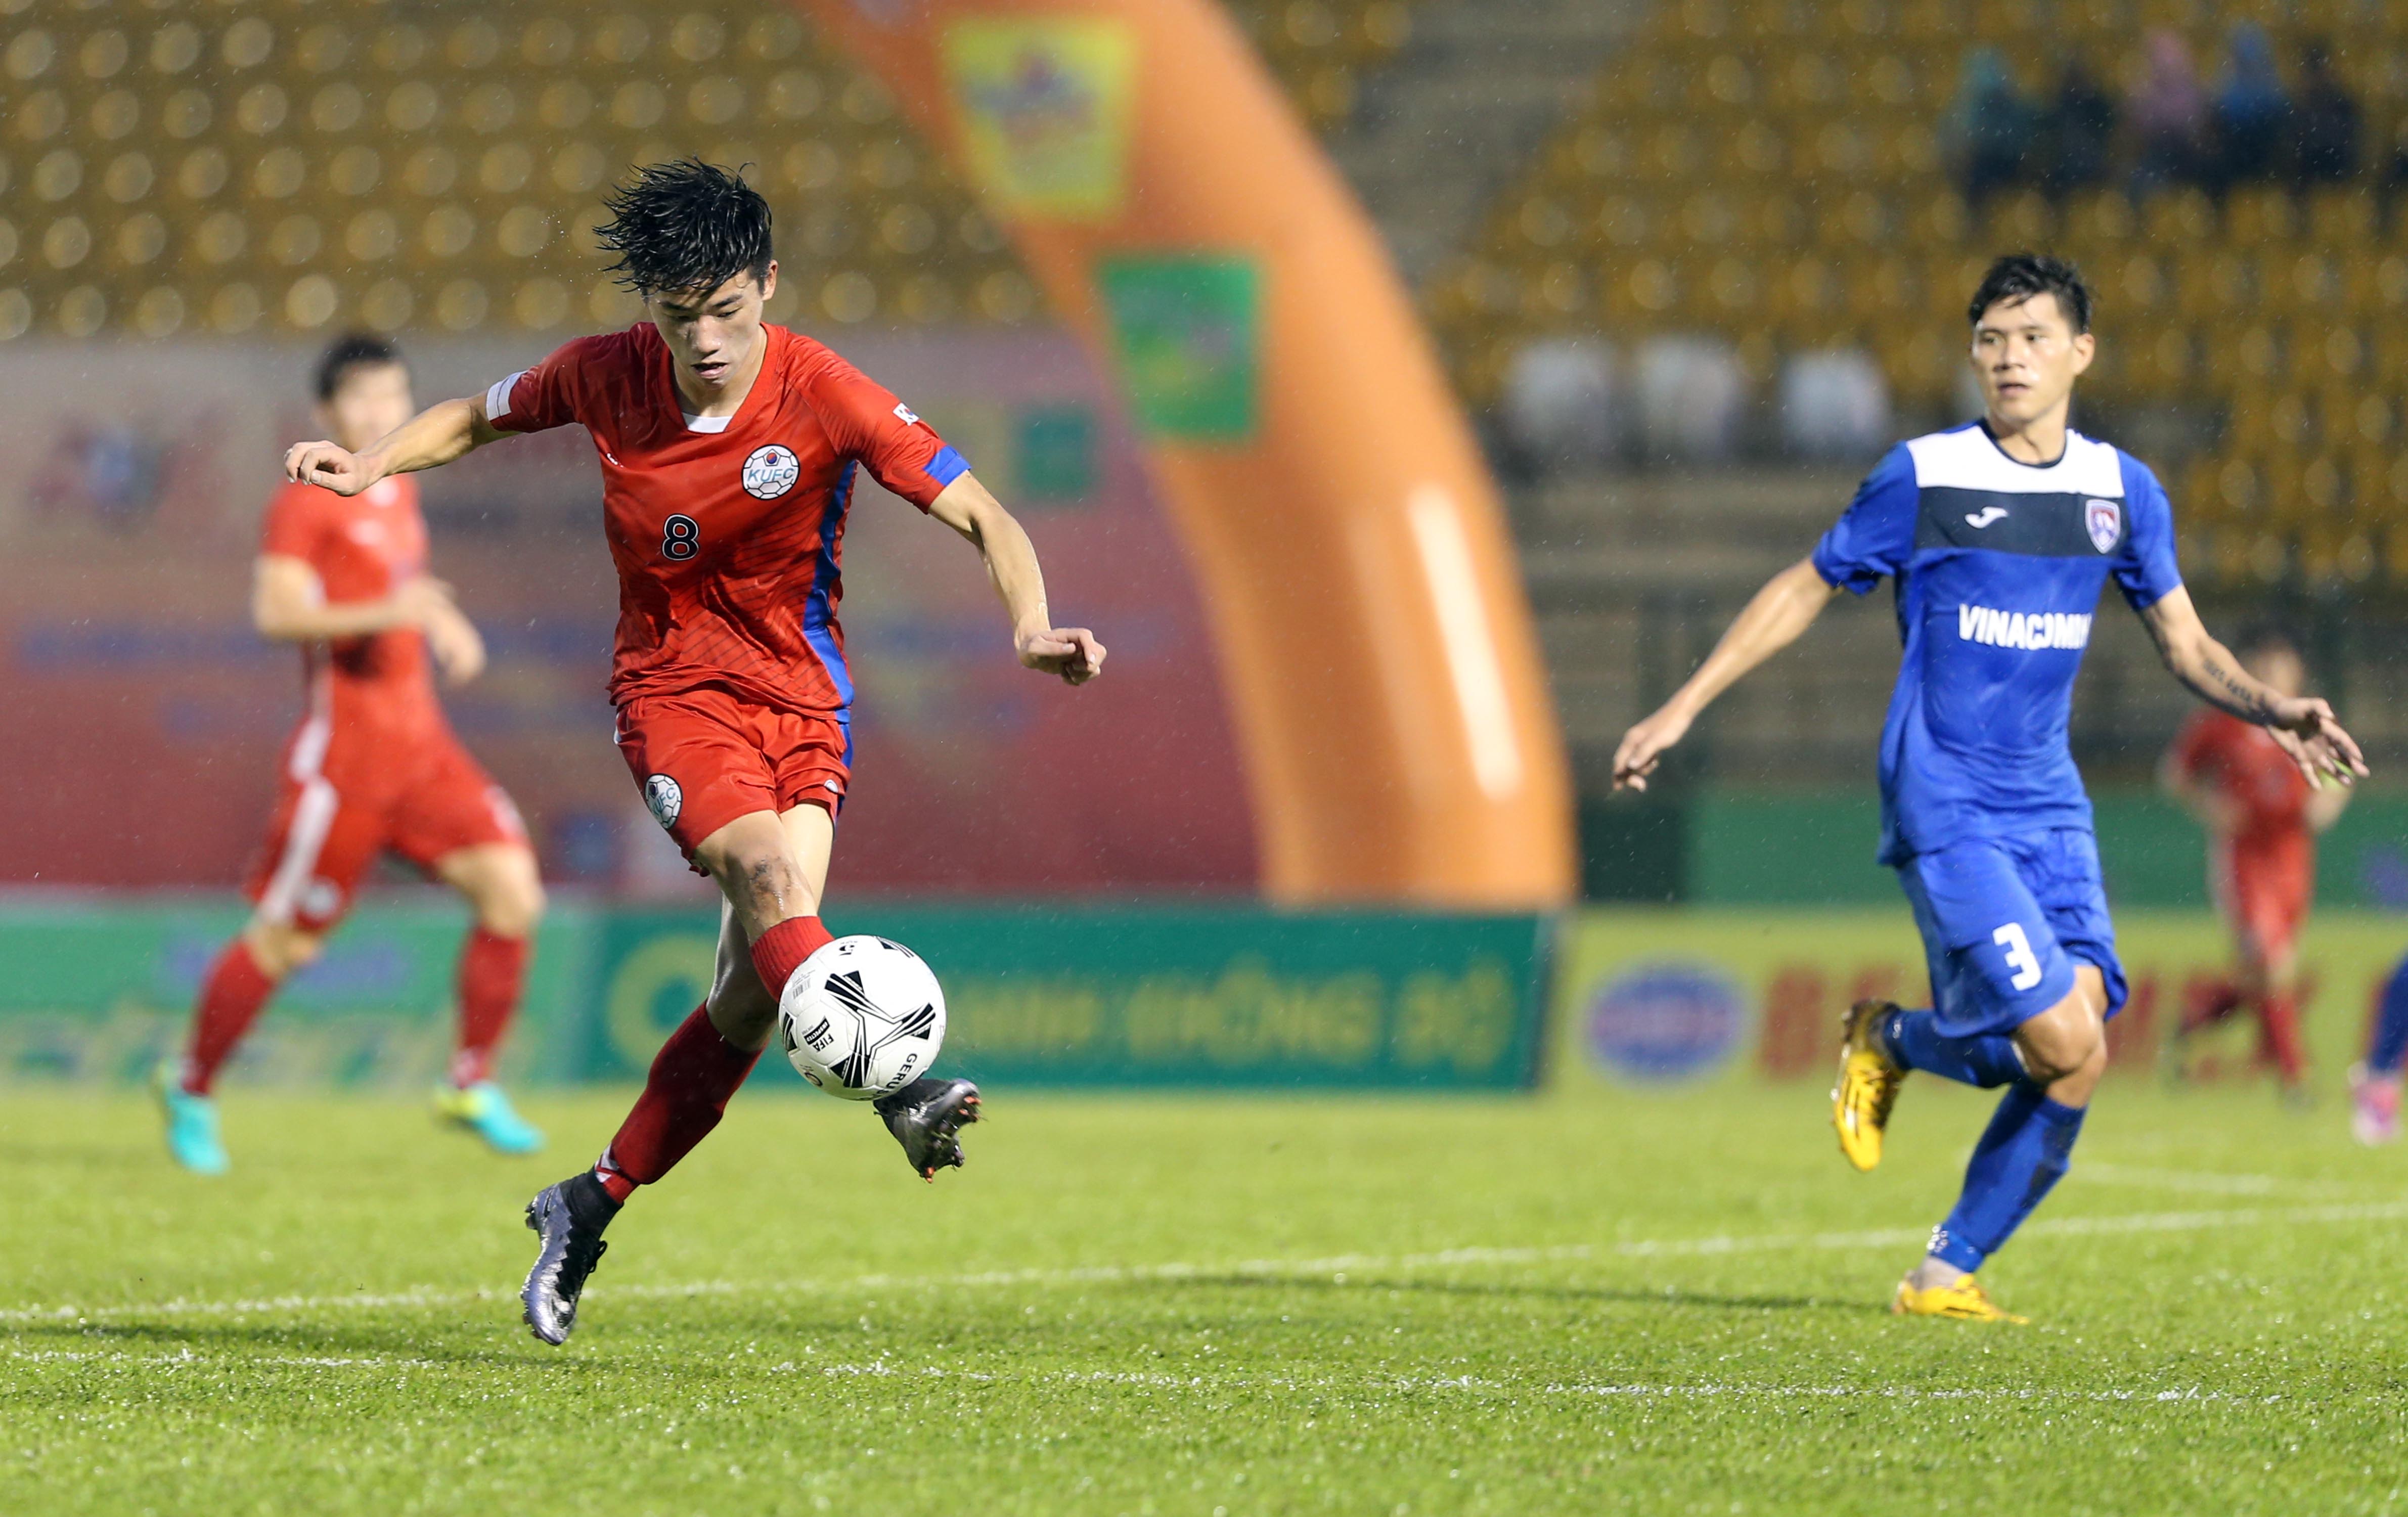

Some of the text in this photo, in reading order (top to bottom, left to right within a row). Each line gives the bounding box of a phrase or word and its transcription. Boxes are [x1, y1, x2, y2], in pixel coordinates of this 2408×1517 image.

[747, 468, 794, 482] KUFC
[662, 514, 699, 561] 8
[1992, 921, 2042, 992] 3
[812, 1033, 835, 1052] FIFA
